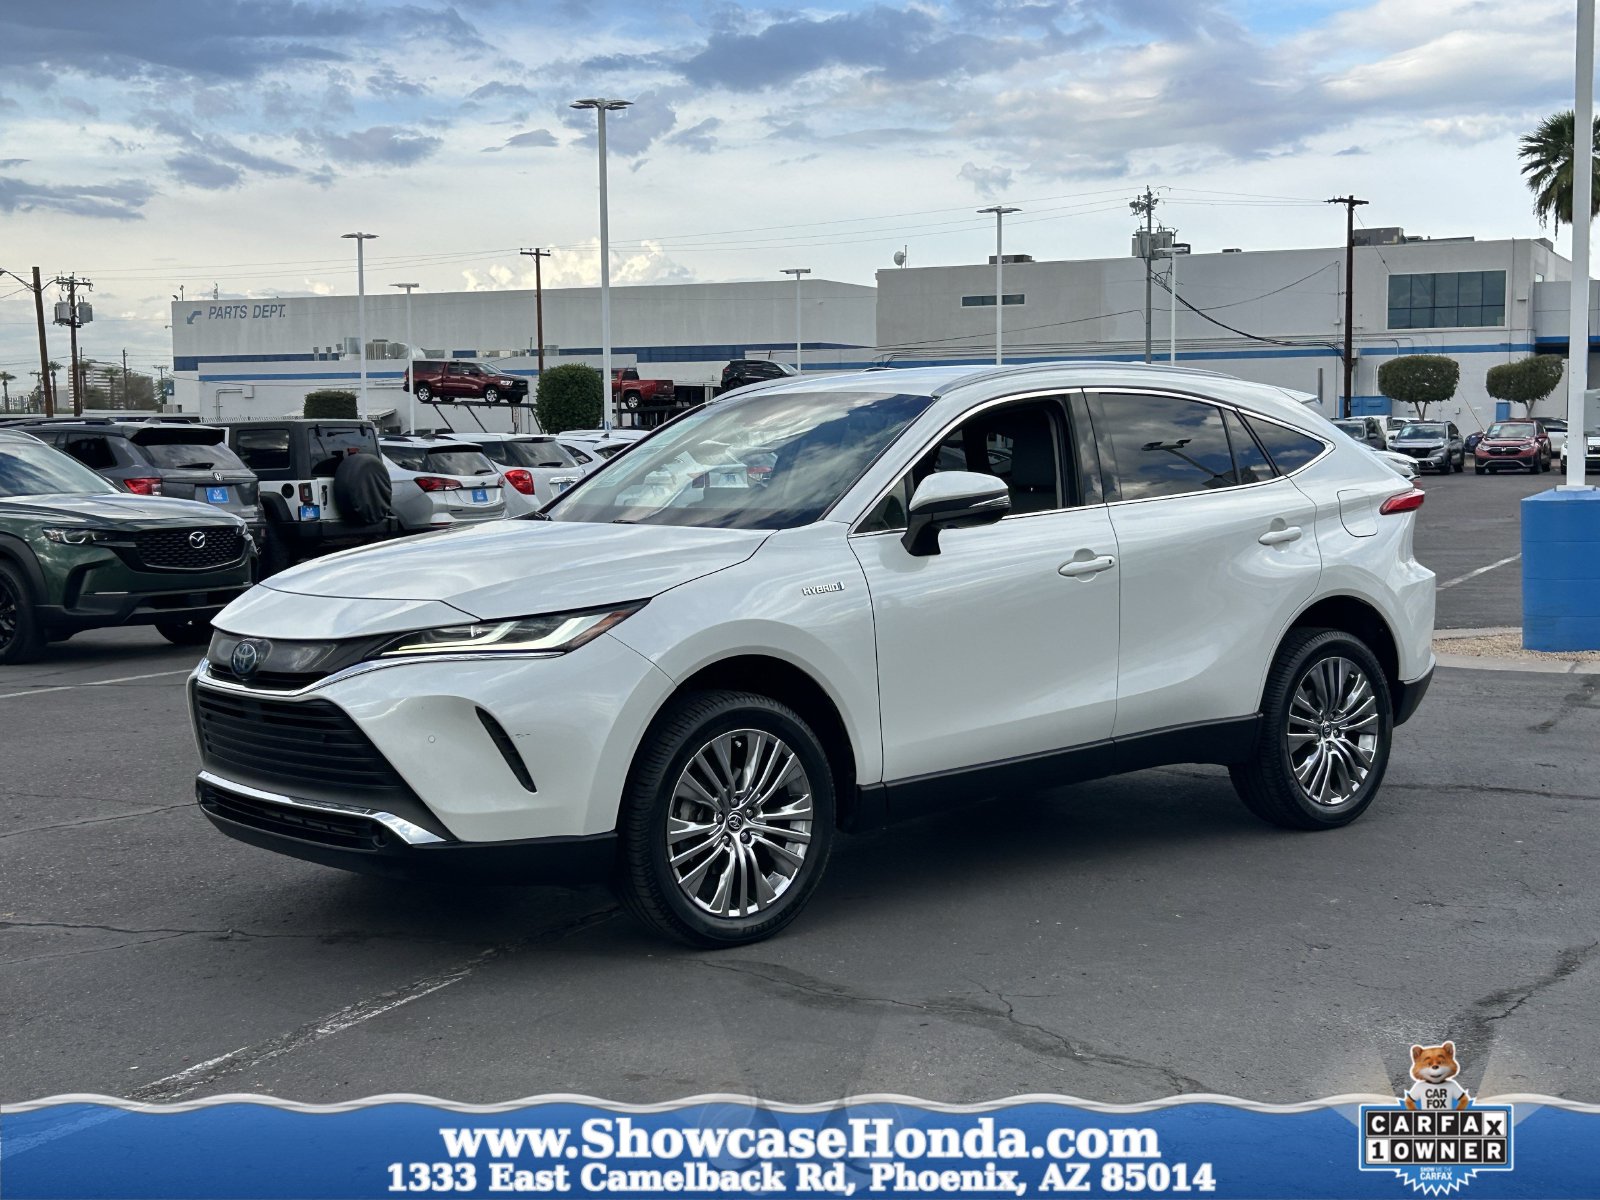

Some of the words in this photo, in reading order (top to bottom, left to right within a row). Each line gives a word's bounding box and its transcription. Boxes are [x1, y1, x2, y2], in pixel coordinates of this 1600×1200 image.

[208, 305, 248, 319] PARTS
[252, 304, 286, 319] DEPT.
[802, 583, 839, 596] HYBRID
